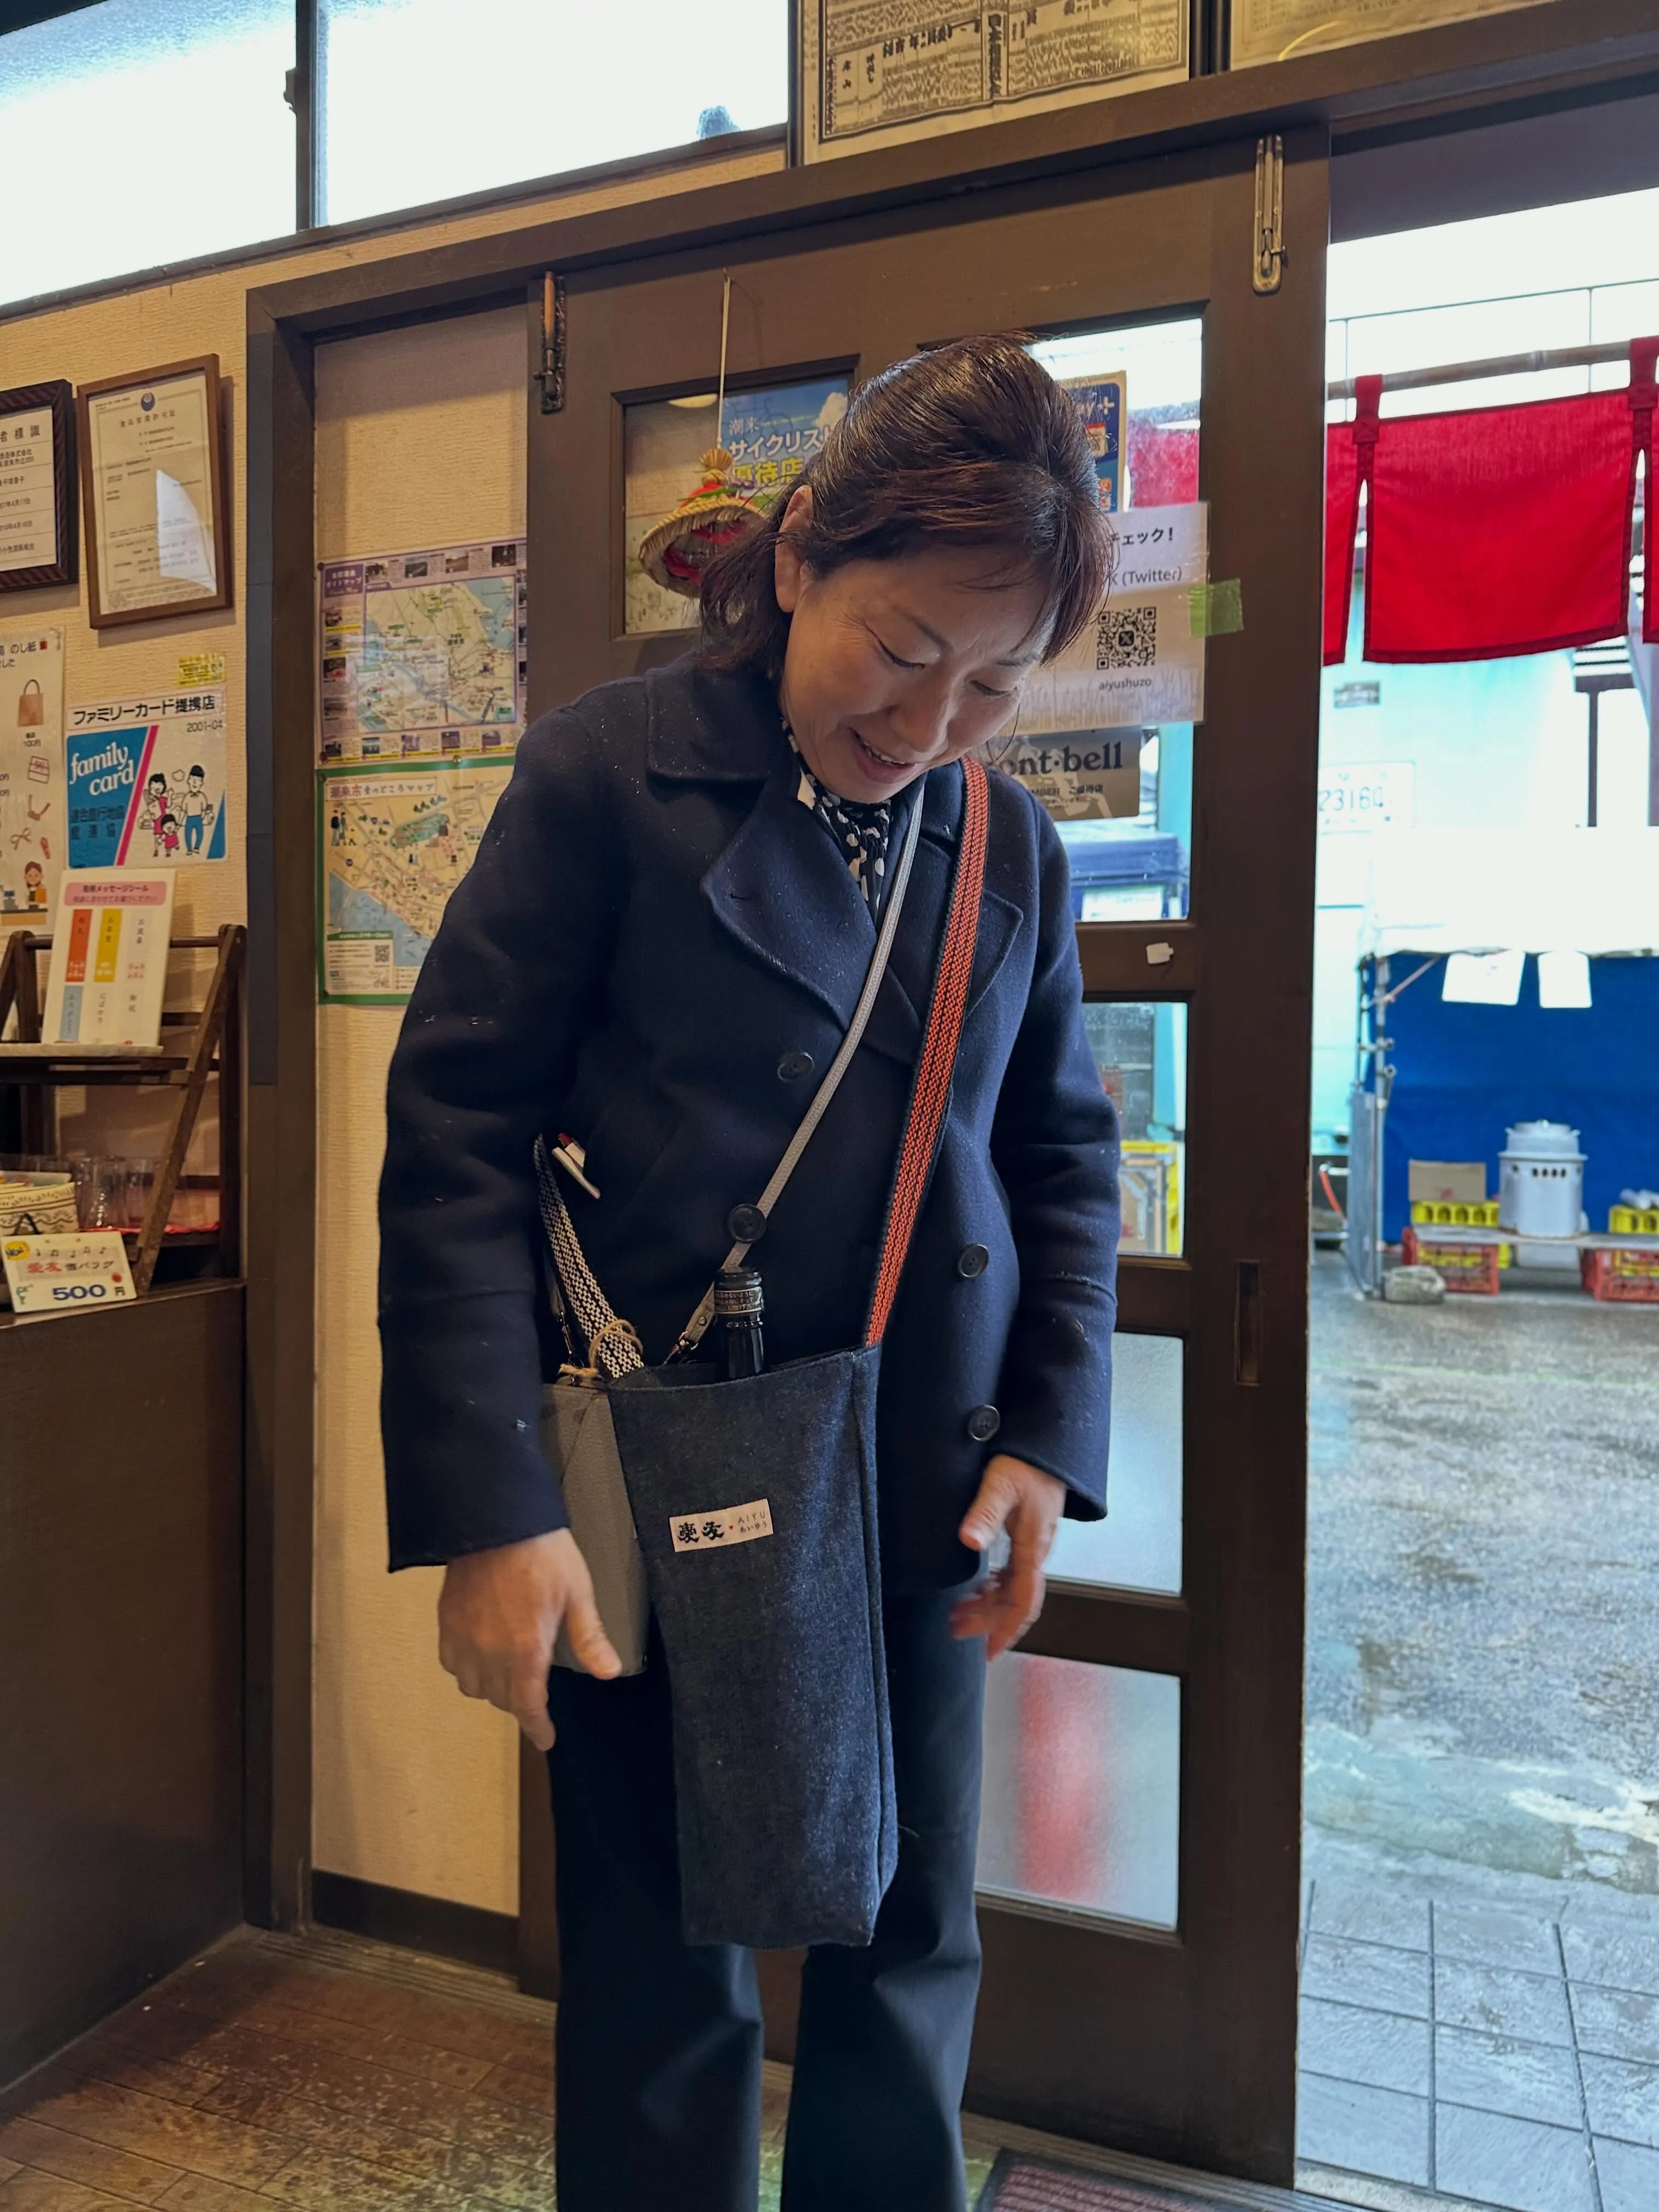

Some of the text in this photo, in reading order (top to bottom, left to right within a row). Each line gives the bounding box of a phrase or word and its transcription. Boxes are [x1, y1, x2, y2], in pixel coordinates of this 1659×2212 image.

[1122, 566, 1182, 586] (Twitter)
[1099, 678, 1152, 691] aiyushuzo
[74, 695, 216, 725] ファミリーカード提携店
[69, 742, 128, 785] family
[999, 741, 1124, 776] ont·bell
[89, 759, 134, 795] card
[52, 1284, 126, 1301] 500 円
[738, 1510, 765, 1524] AIYU
[740, 1522, 767, 1533] あいゆう
